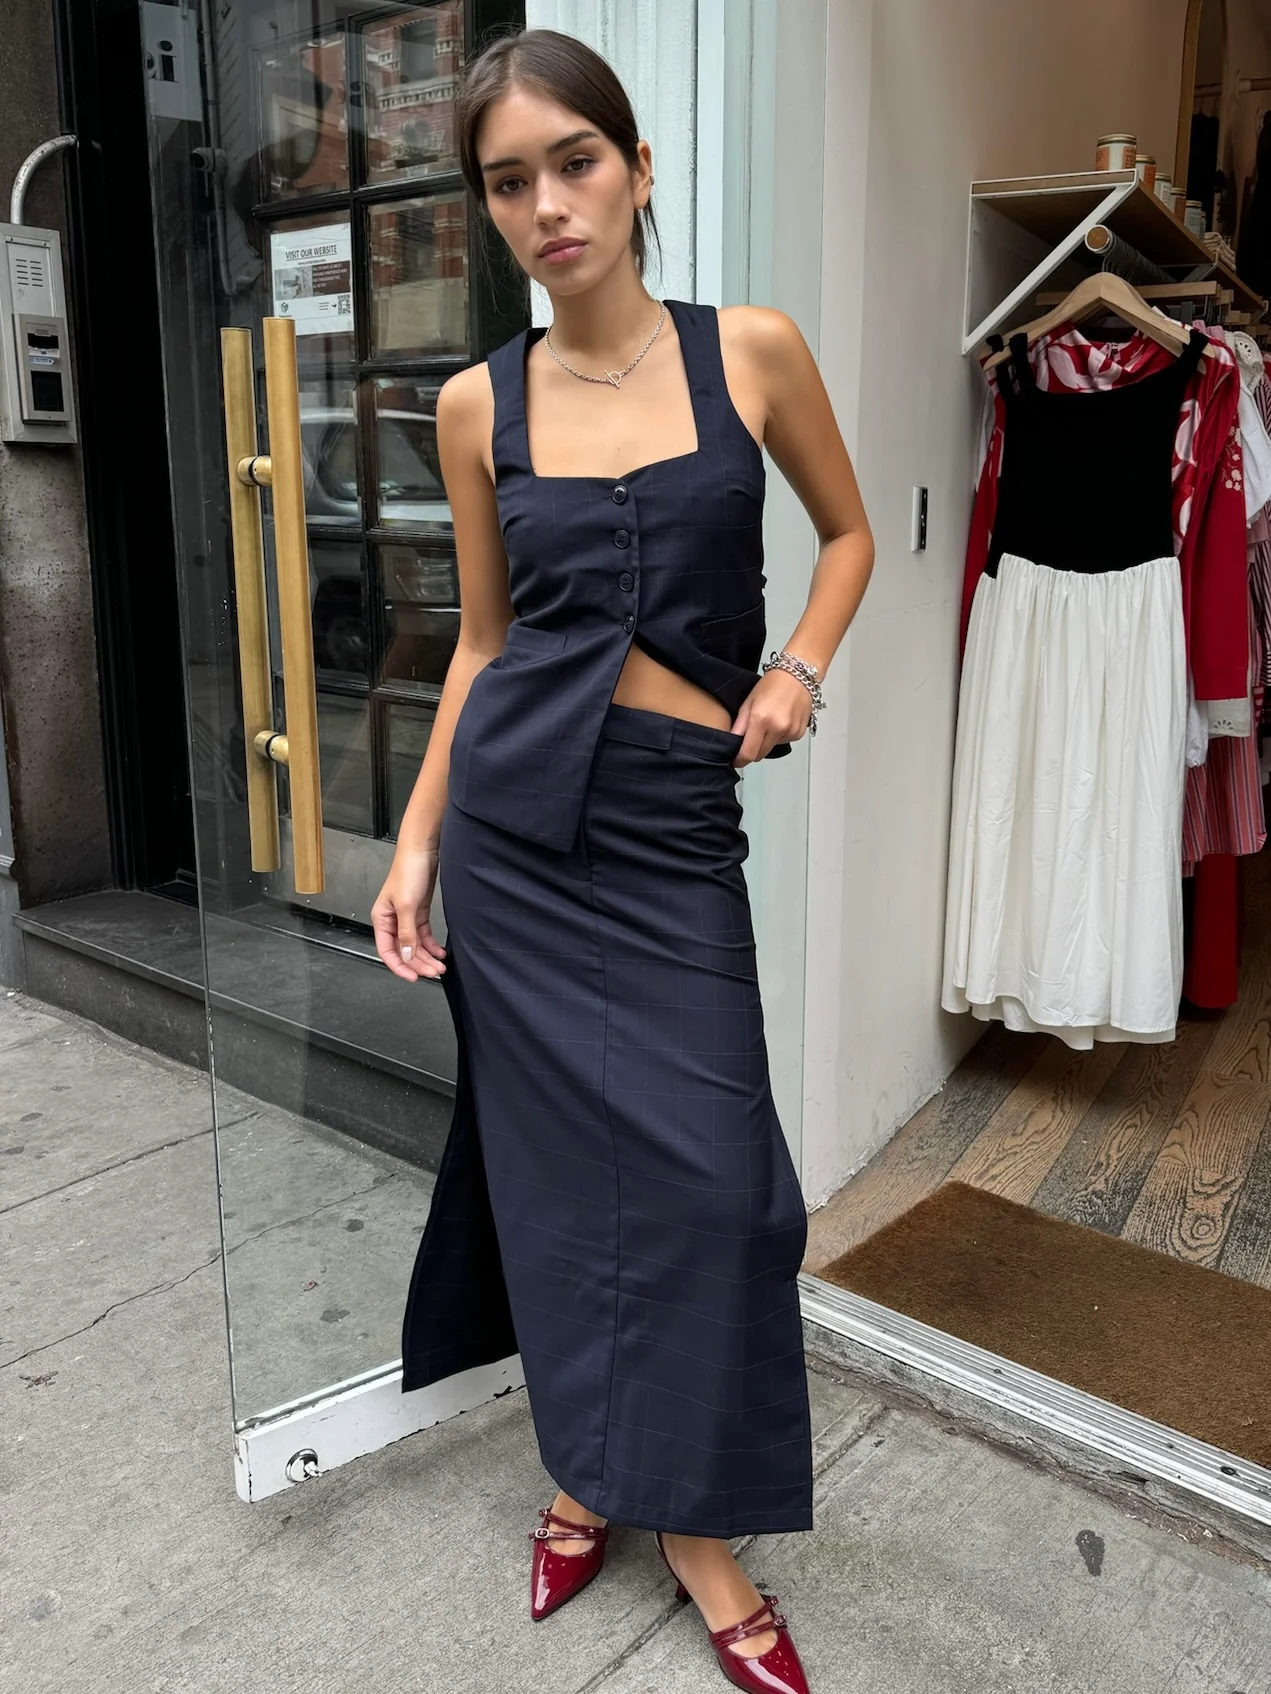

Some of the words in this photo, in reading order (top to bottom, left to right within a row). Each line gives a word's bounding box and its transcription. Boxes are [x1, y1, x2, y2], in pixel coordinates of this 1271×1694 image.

[285, 250, 299, 259] VISIT
[300, 248, 312, 257] OUR
[313, 244, 337, 255] WEBSITE
